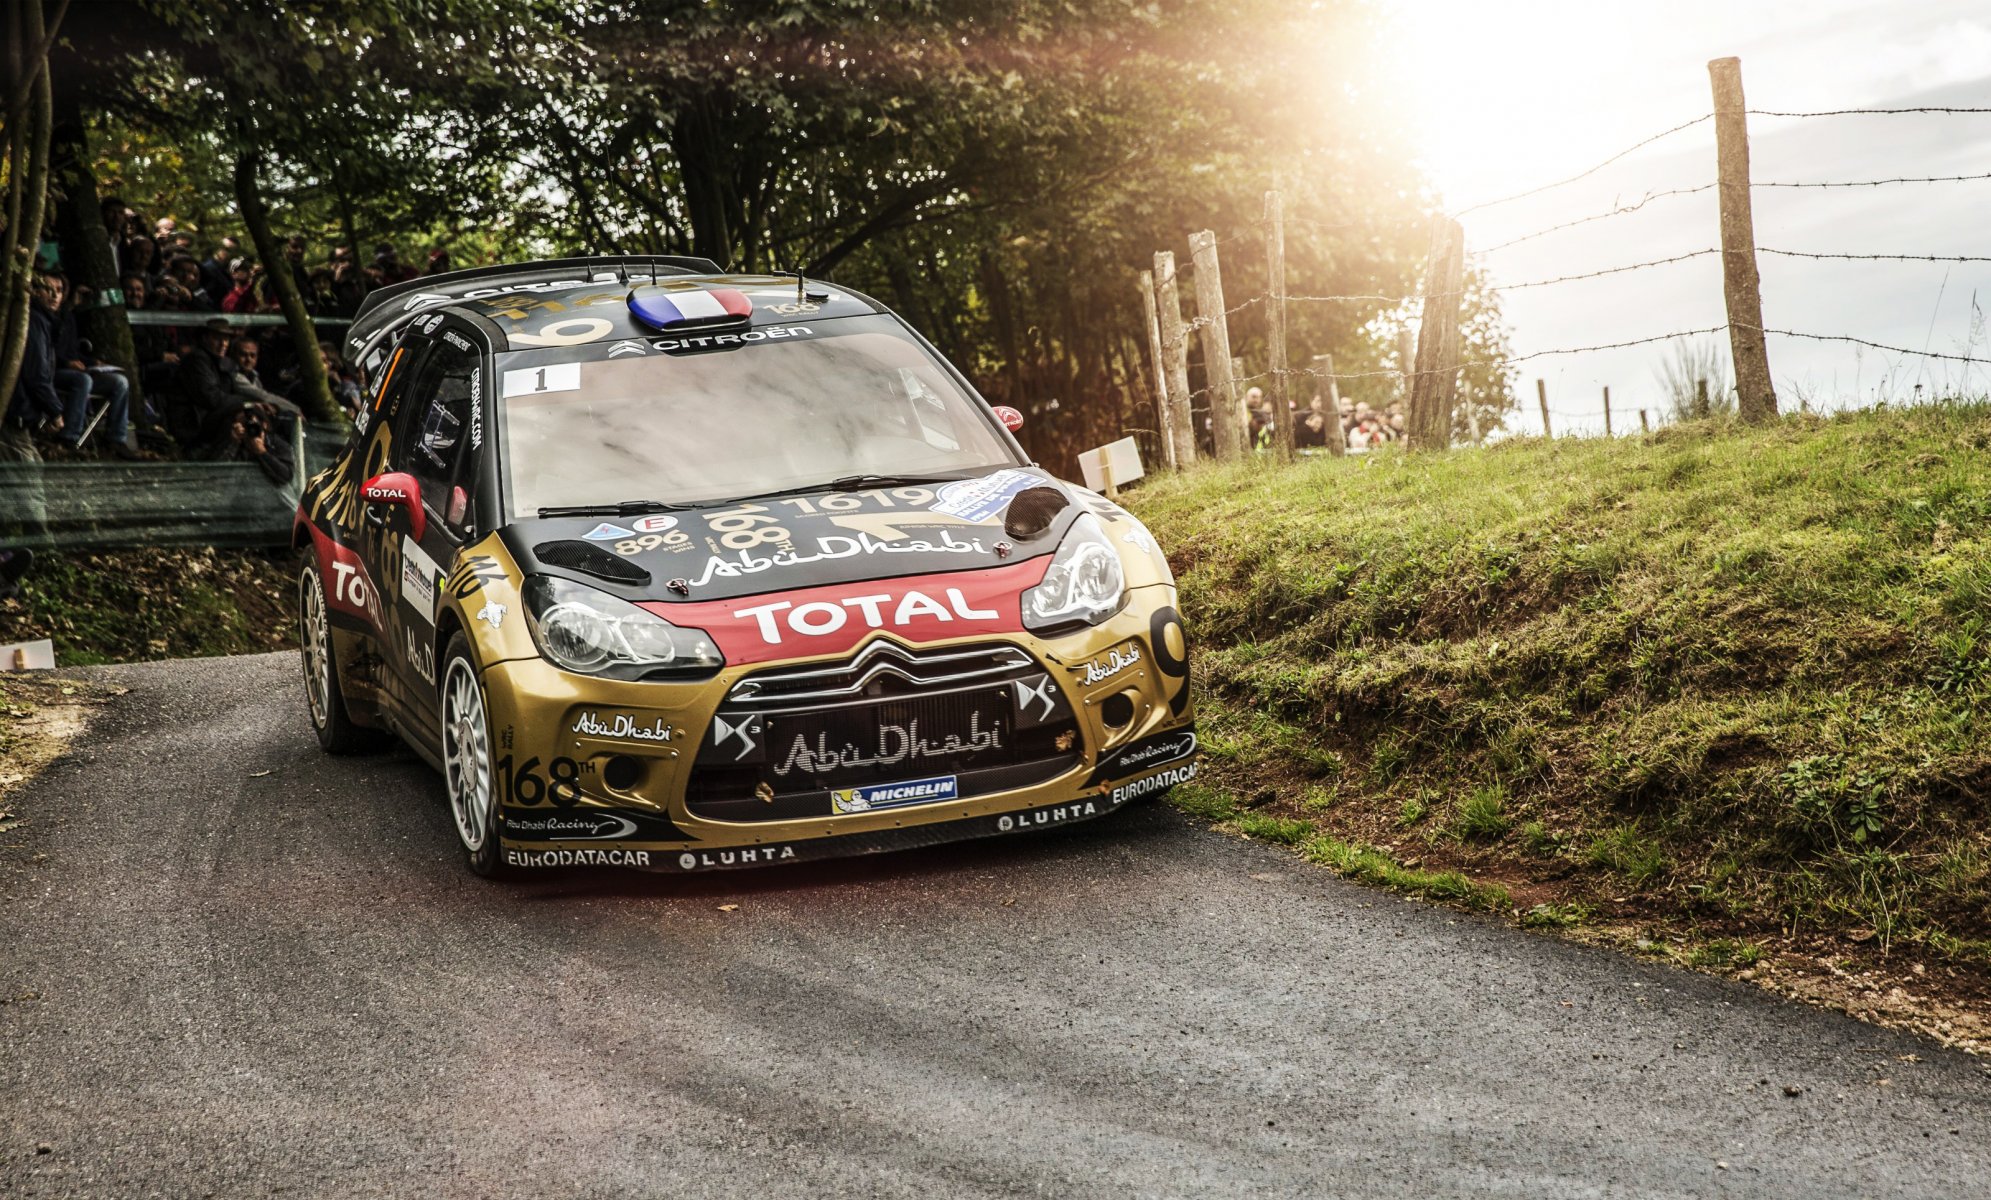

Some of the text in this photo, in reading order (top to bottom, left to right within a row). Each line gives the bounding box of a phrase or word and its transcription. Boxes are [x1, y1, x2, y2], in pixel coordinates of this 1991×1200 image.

[653, 327, 814, 351] CITROËN
[534, 368, 548, 392] 1
[366, 487, 407, 498] TOTAL
[781, 486, 934, 515] 1619
[614, 529, 689, 556] 896
[733, 588, 1000, 644] TOTAL
[499, 754, 596, 808] 168 TH
[870, 781, 955, 802] MICHELIN
[506, 818, 612, 835] Abu Dhabi Racing
[1018, 802, 1096, 827] LUHTA
[508, 850, 650, 867] EURODATACAR
[702, 846, 795, 866] LUHTA
